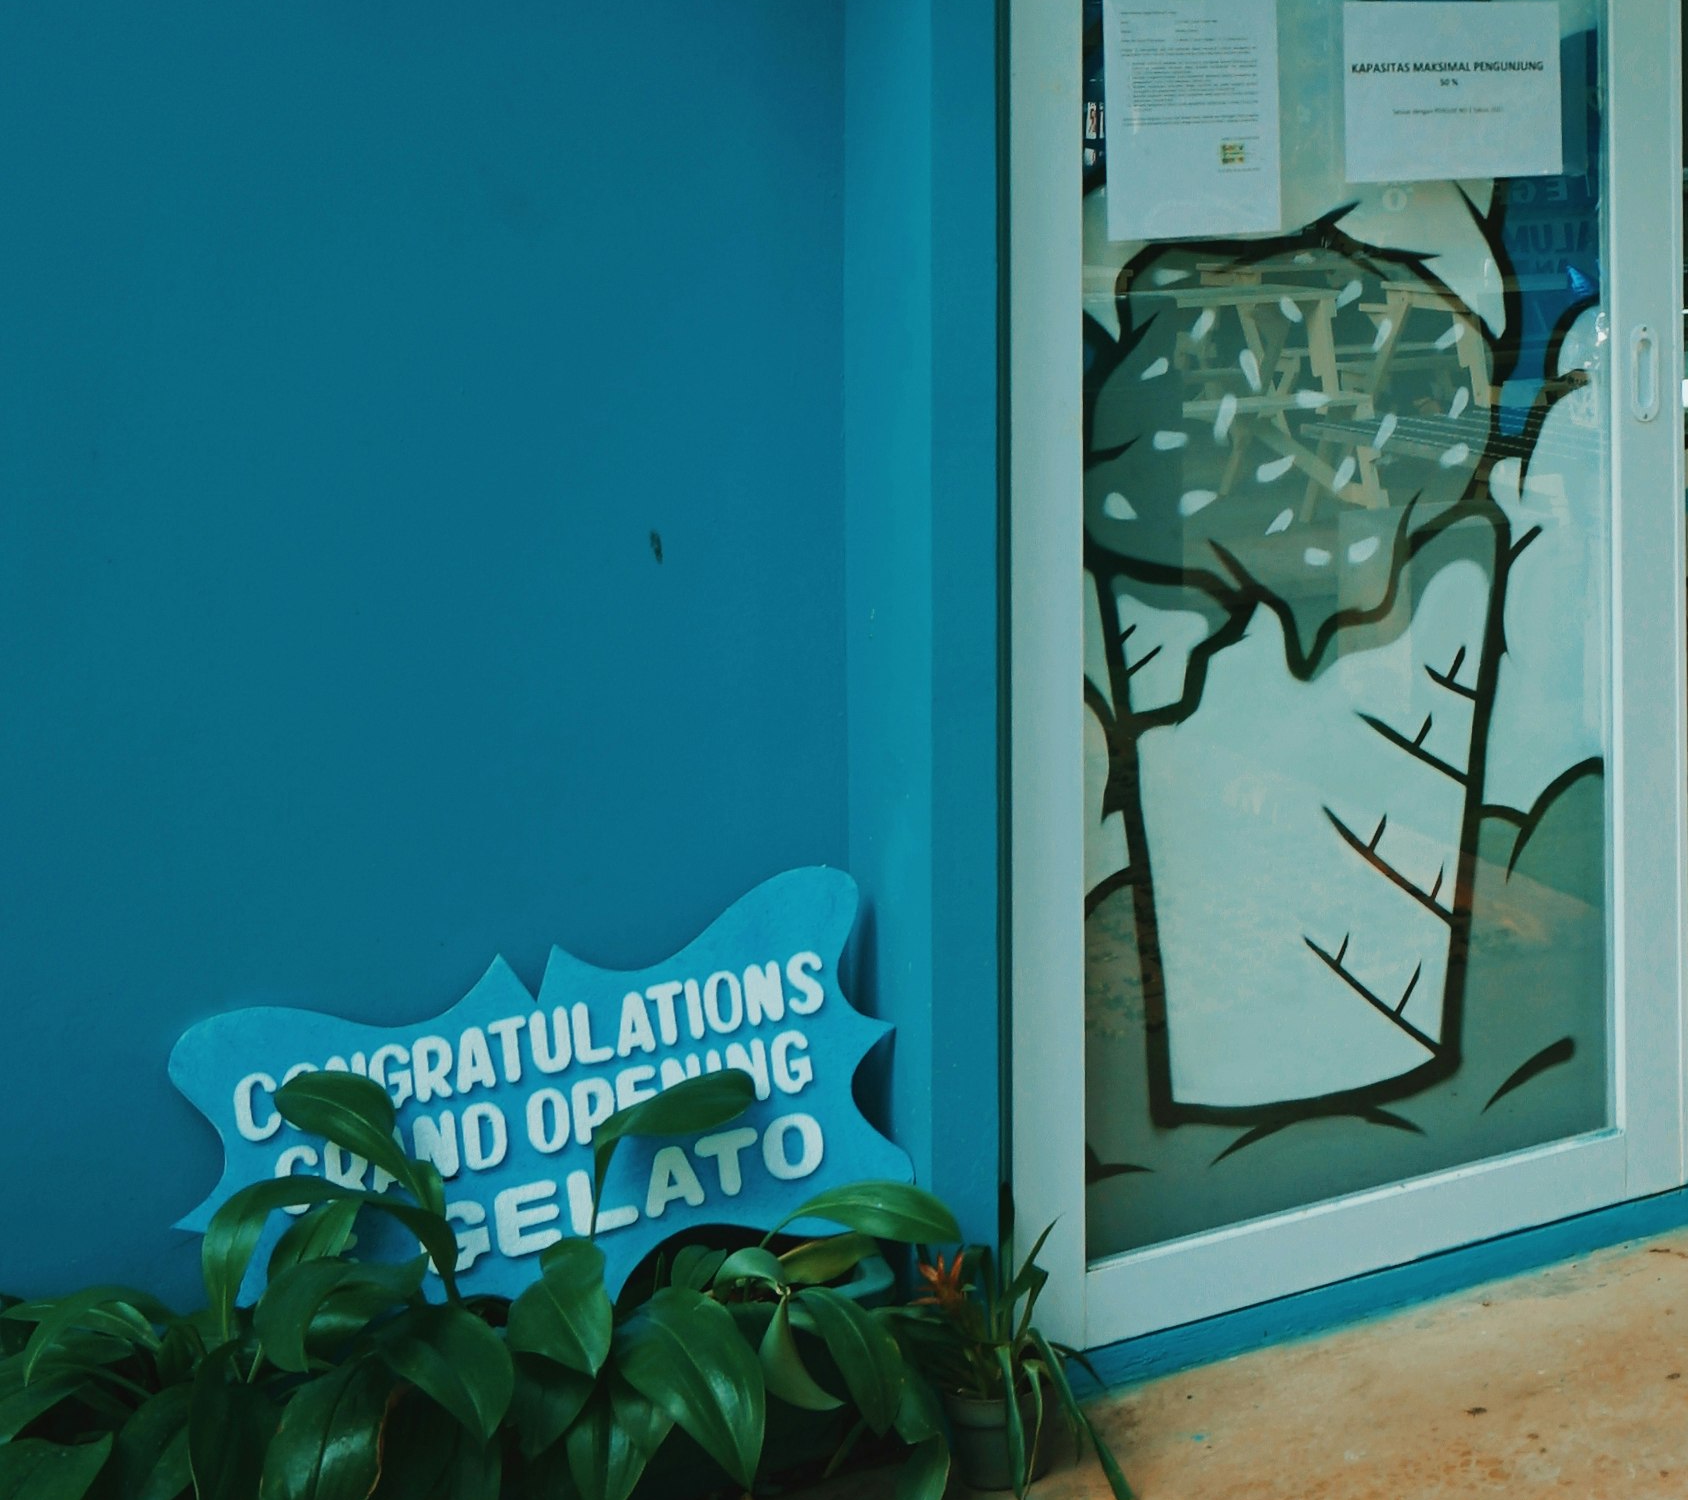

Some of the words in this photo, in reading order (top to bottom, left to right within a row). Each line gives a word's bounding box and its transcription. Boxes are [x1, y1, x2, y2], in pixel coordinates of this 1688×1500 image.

[1351, 61, 1411, 74] KAPASITAS
[1413, 61, 1471, 73] MAKSIMAL
[1473, 60, 1544, 72] PENGUNJUNG
